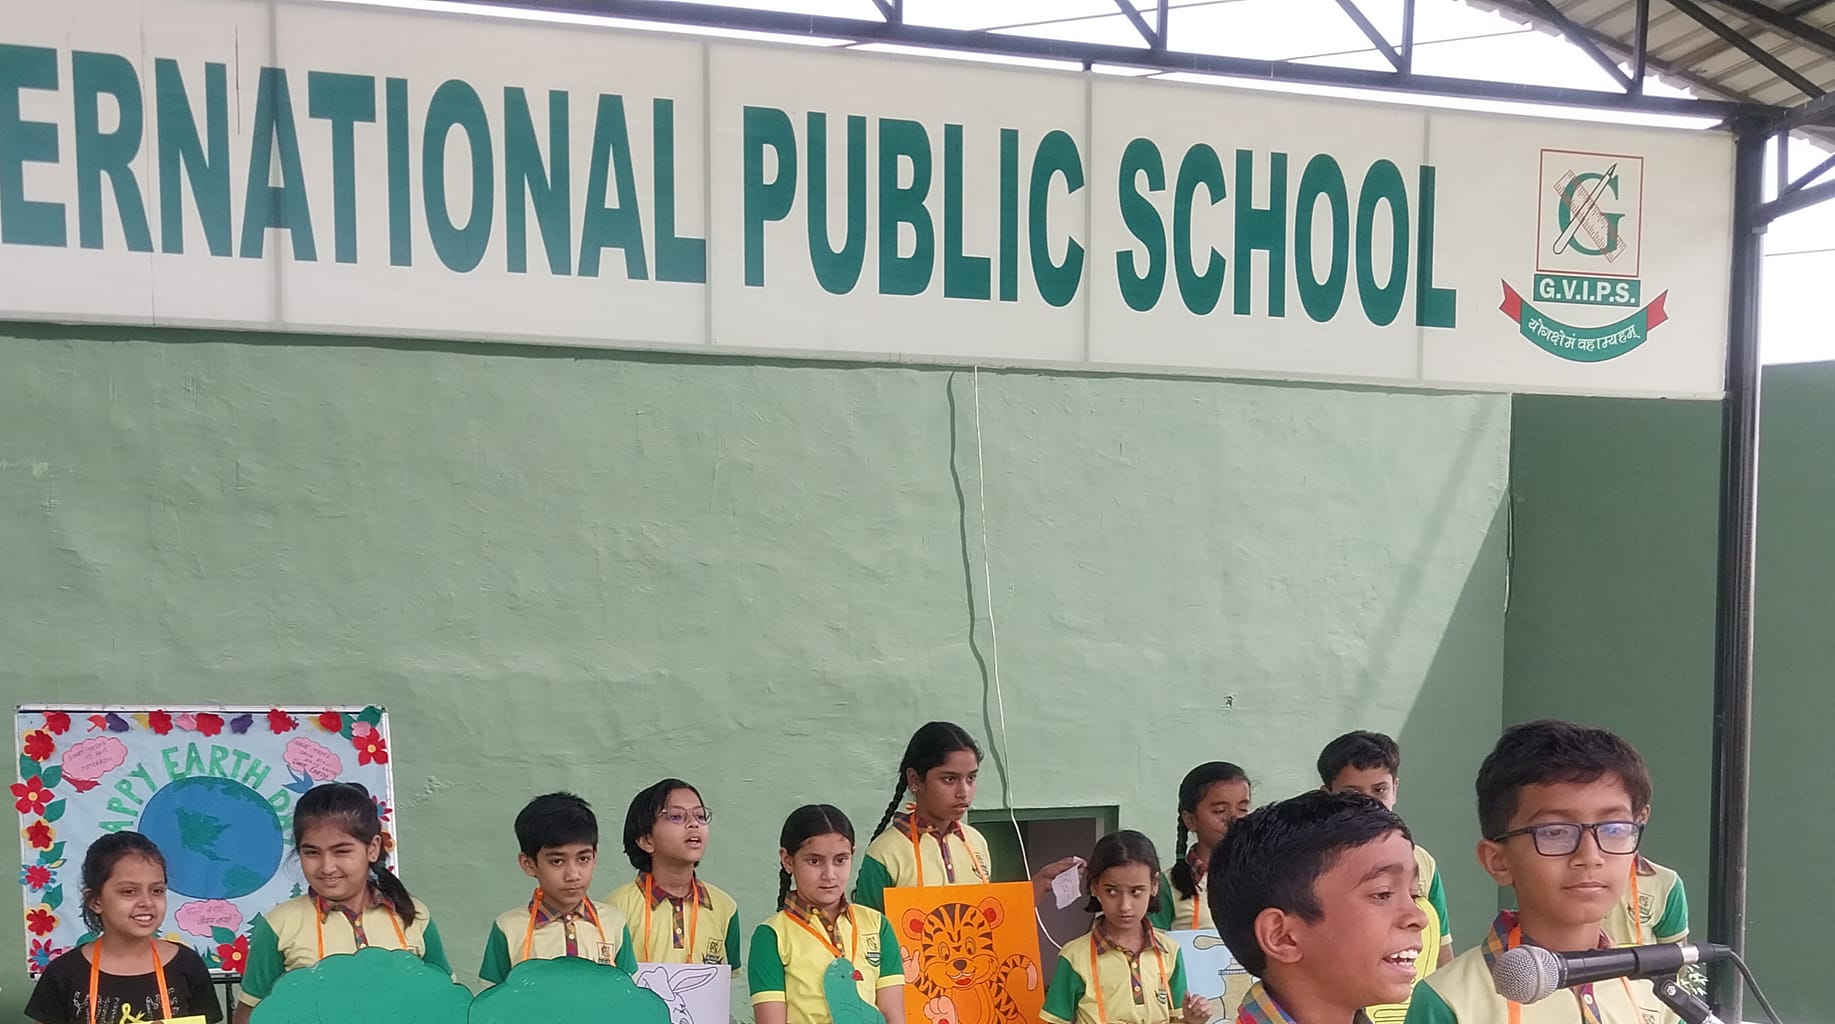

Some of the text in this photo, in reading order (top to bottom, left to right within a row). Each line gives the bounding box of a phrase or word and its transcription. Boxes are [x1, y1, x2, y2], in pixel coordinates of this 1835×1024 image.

[0, 43, 1457, 328] ERNATIONAL PUBLIC SCHOOL
[1539, 278, 1636, 304] G.V.I.P.S.
[98, 762, 158, 833] APPY
[161, 742, 272, 790] EARTH
